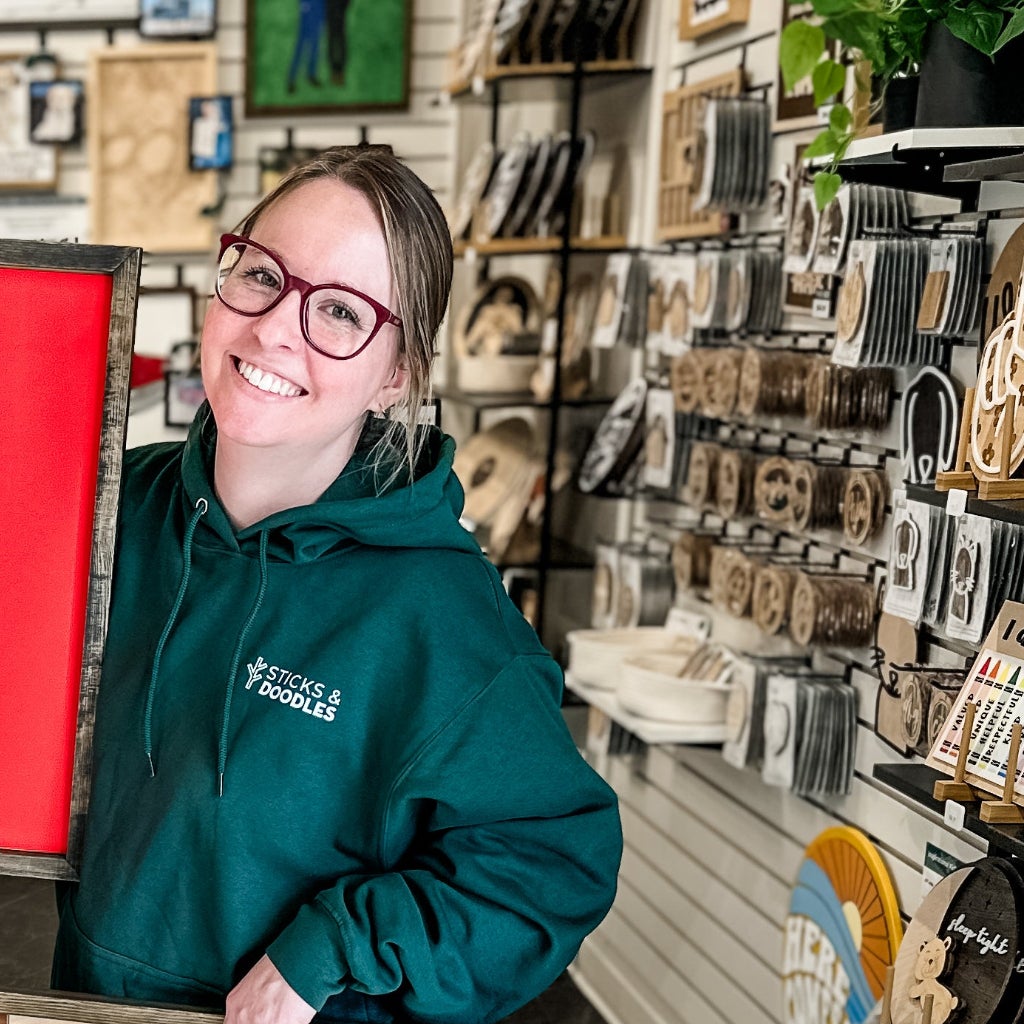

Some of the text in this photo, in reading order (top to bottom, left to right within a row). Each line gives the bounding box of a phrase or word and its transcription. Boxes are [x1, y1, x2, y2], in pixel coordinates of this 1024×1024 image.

[258, 680, 337, 722] DOODLES
[266, 666, 341, 706] STICKS &
[970, 699, 995, 740] UNIQUE
[979, 700, 1007, 745] HELPFUL
[986, 696, 1020, 756] RESPECTFUL
[947, 913, 1009, 955] sleep tight
[782, 914, 851, 1008] HERE
